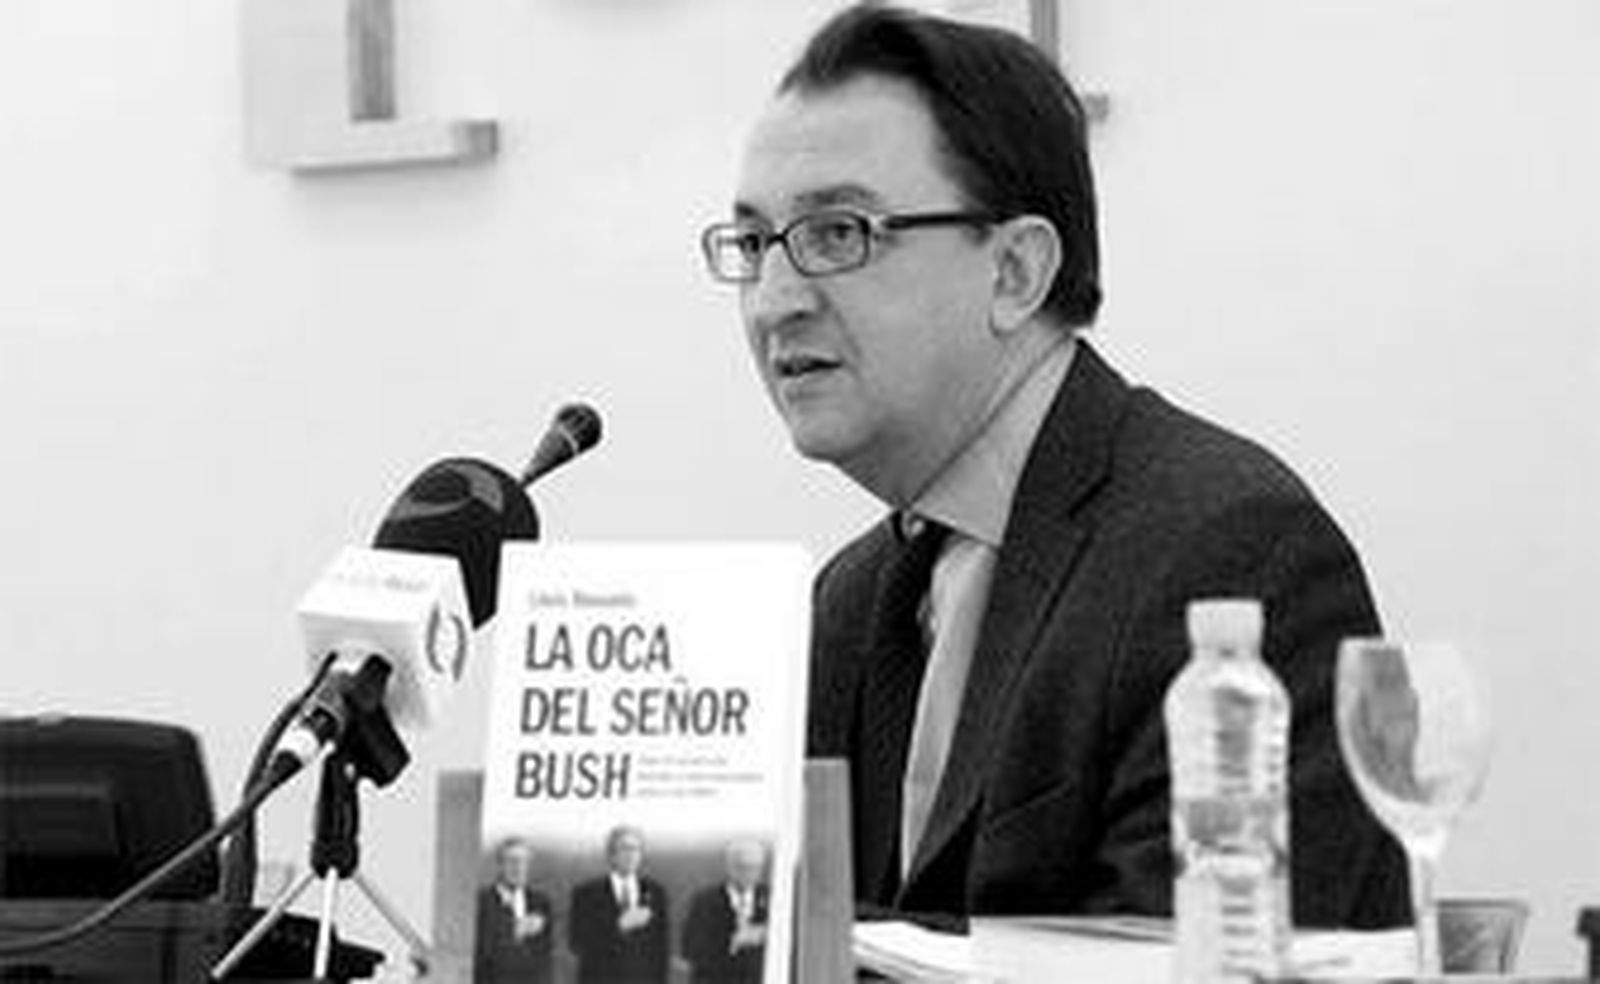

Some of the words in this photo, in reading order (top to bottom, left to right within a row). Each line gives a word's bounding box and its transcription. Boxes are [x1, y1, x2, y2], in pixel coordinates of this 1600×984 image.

[525, 623, 574, 671] LA
[586, 623, 672, 672] OCA
[520, 687, 597, 735] DEL
[610, 675, 750, 736] SEÑOR
[515, 752, 631, 800] BUSH
